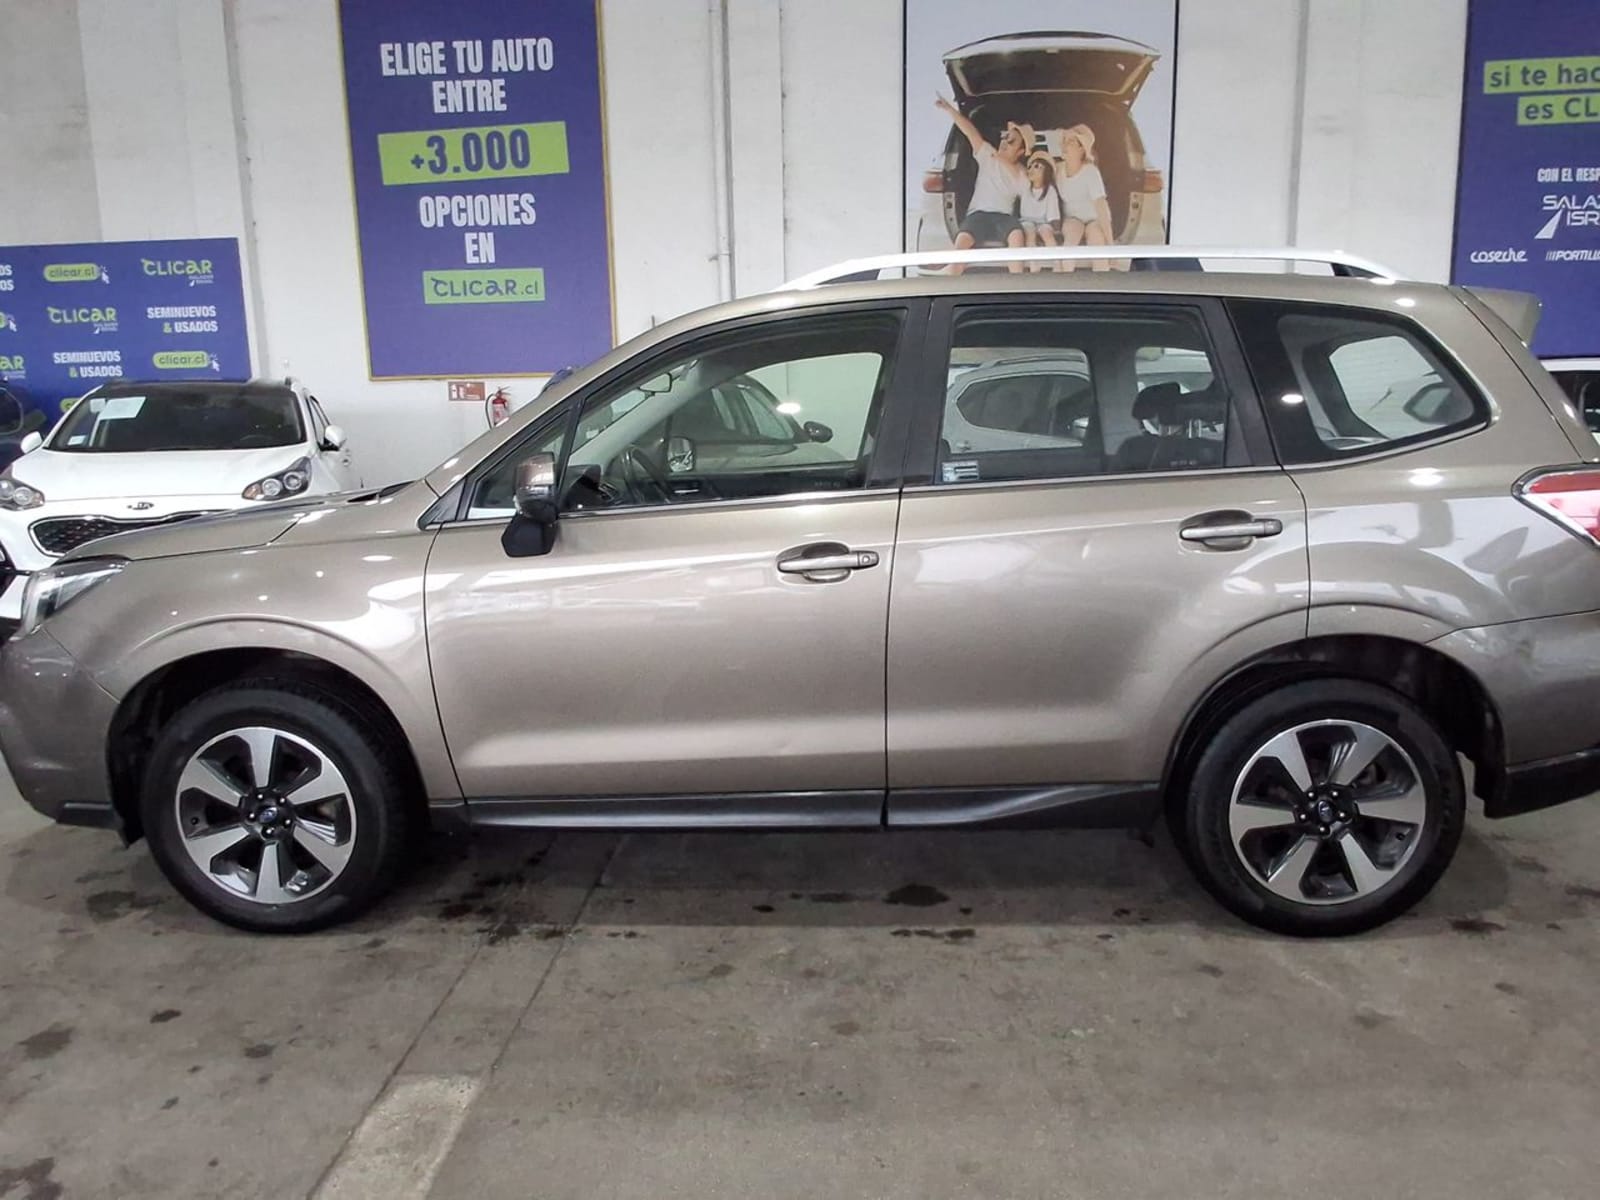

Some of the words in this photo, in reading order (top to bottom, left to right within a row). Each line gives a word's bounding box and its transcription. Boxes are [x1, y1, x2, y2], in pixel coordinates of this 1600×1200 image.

[380, 42, 447, 76] ELIGE
[452, 40, 484, 74] TU
[491, 37, 553, 72] AUTO
[1489, 65, 1511, 88] si
[1521, 65, 1547, 86] te
[432, 79, 507, 113] ENTRE
[1525, 103, 1554, 120] es
[1564, 97, 1599, 118] CL
[410, 128, 531, 175] +3.000
[1561, 168, 1573, 182] EL
[419, 193, 536, 228] OPCIONES
[464, 232, 496, 264] EN
[146, 305, 217, 319] SEMINUEVOS
[174, 320, 219, 333] USADOS
[53, 351, 121, 364] SEMINUEVOS
[80, 364, 123, 378] USADOS
